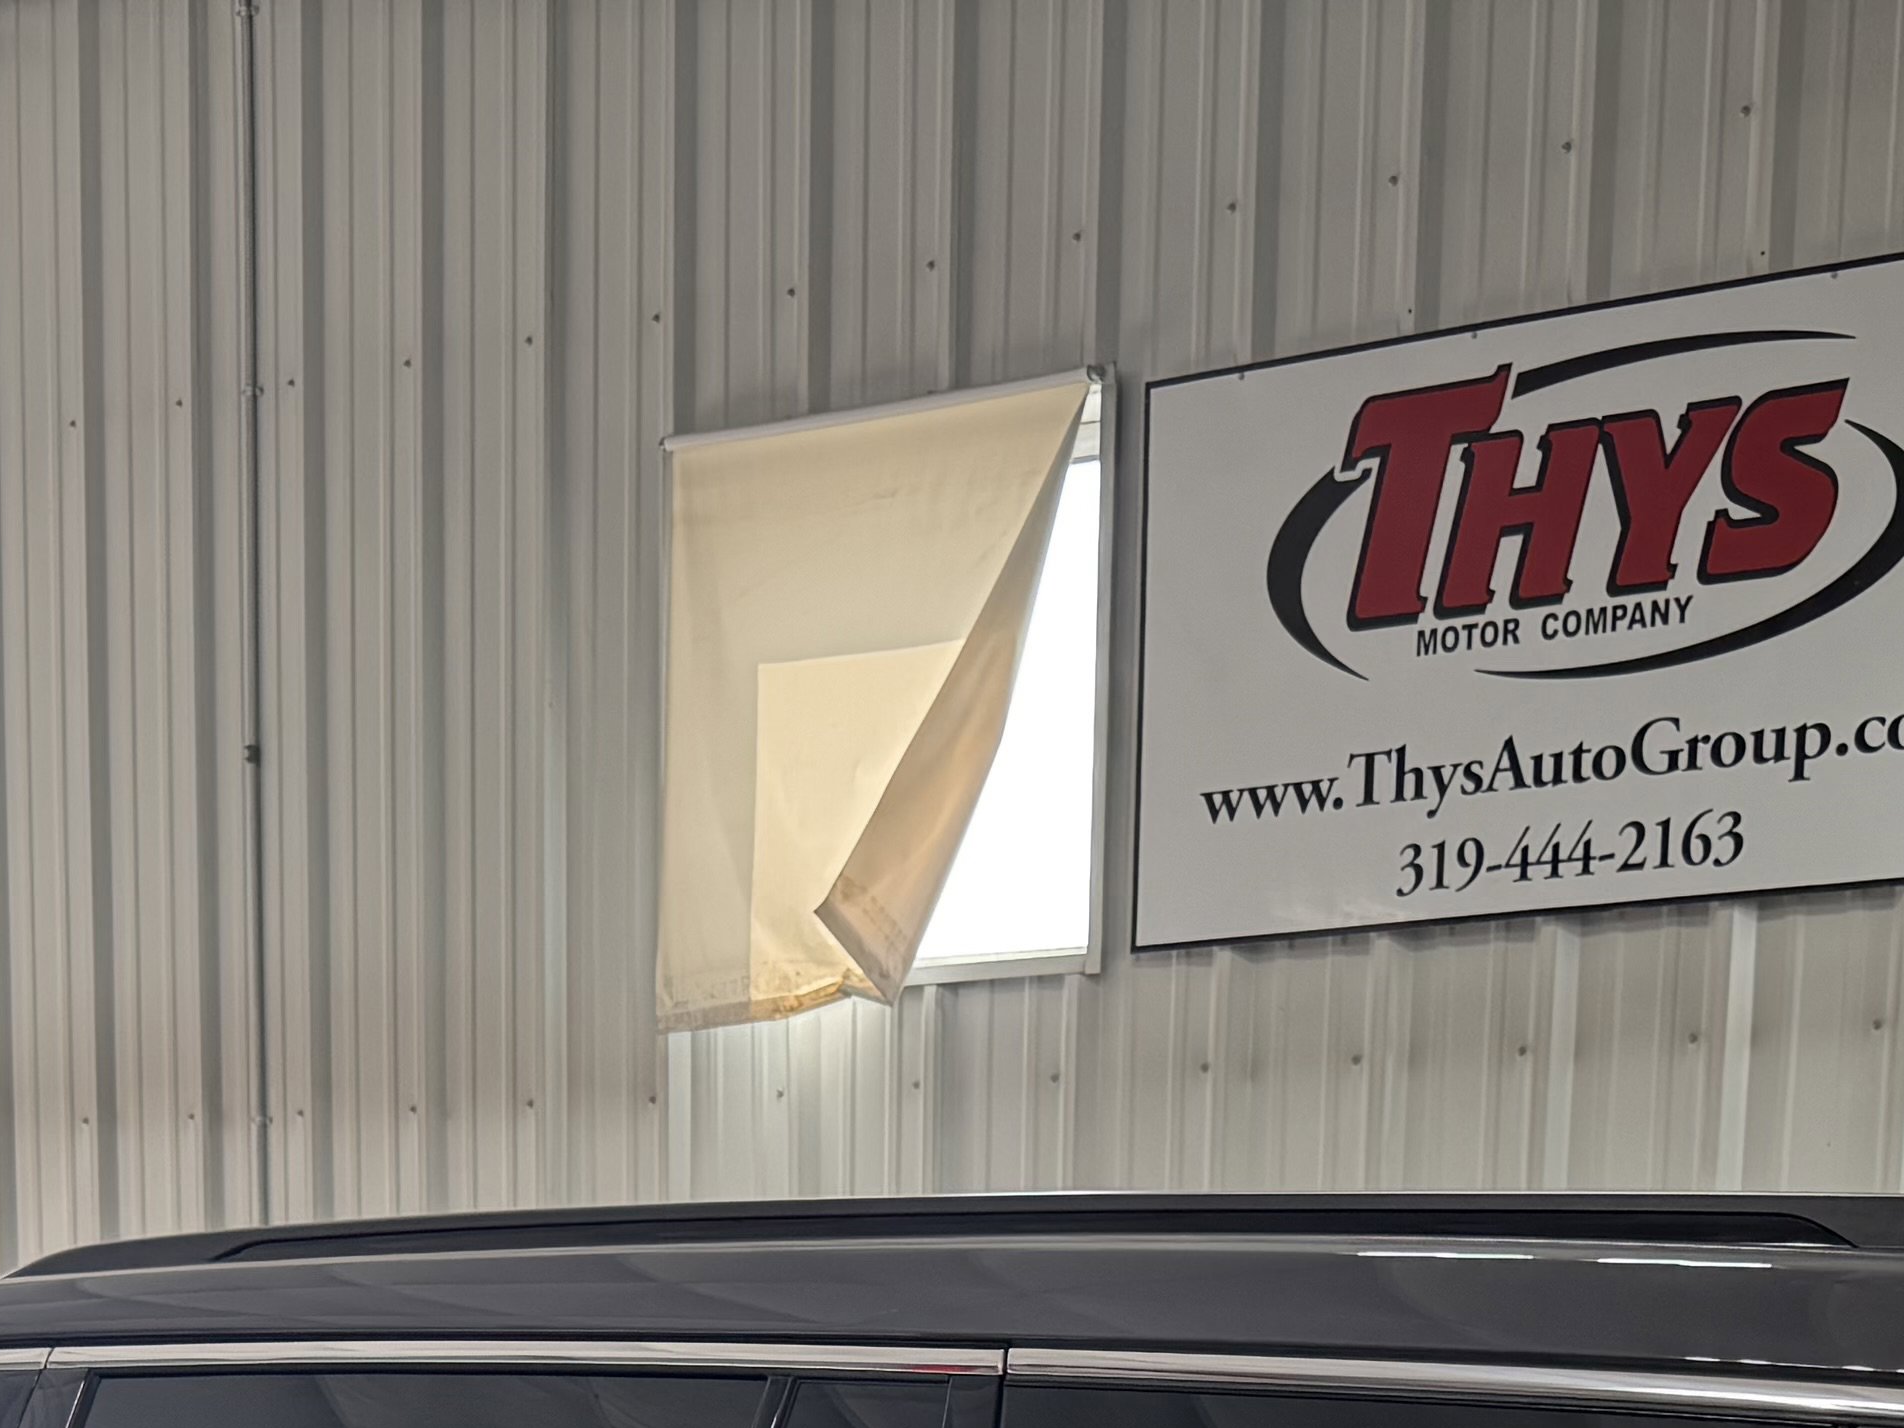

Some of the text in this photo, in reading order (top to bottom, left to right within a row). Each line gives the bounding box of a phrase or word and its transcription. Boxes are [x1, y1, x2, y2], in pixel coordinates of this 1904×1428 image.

[1340, 363, 1850, 631] THYS
[1416, 595, 1694, 657] MOTOR COMPANY
[1396, 810, 1745, 897] 319-444-2163
